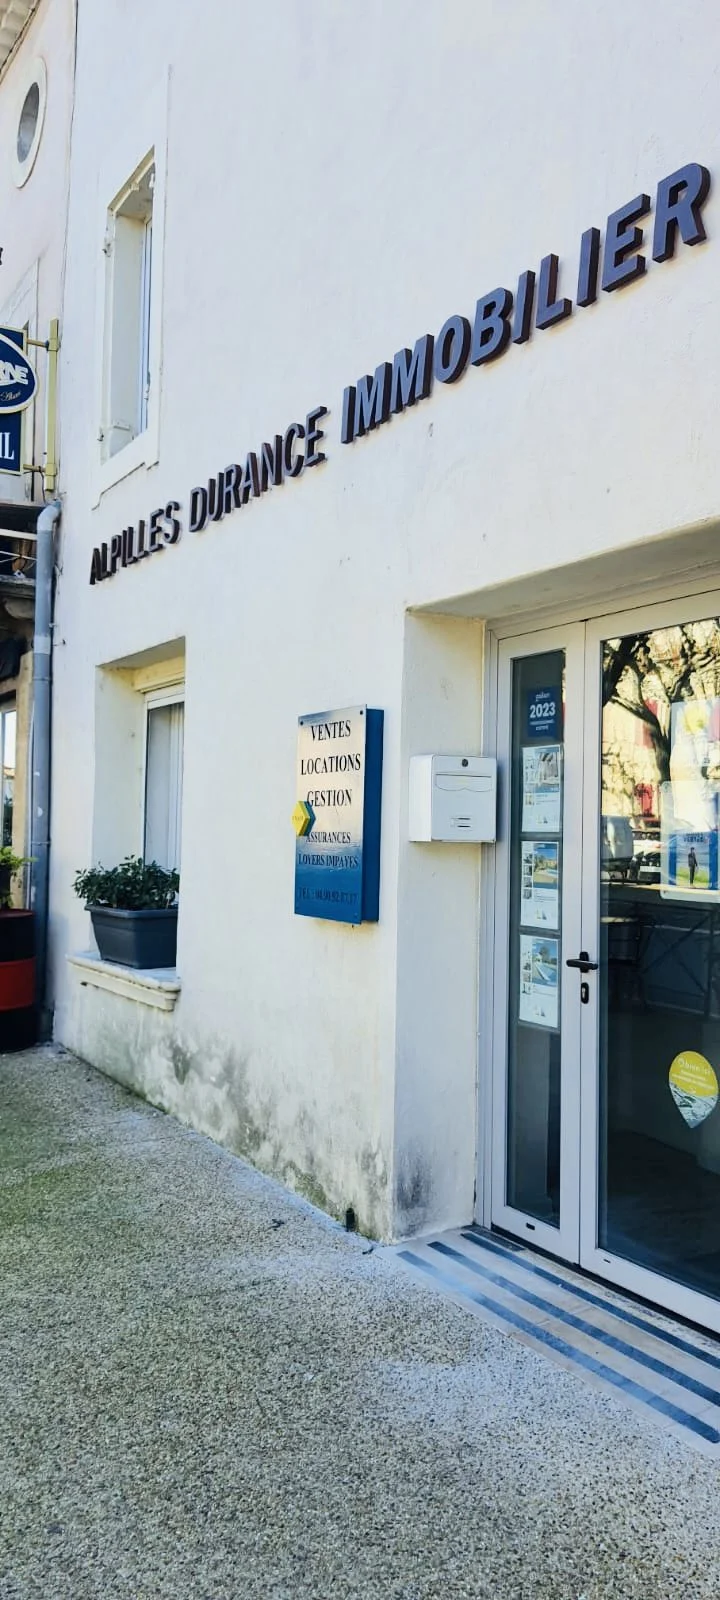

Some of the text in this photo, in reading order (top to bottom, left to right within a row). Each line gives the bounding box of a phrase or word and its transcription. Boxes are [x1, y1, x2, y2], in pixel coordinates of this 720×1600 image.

[90, 163, 711, 585] ALPILLES DURANCE IMMOBILIER
[530, 702, 556, 718] 2023
[311, 720, 351, 741] VENTES
[301, 754, 361, 775] LOCATIONS
[307, 789, 352, 806] GESTION
[306, 832, 351, 843] ASSURANCES
[299, 853, 325, 866] LOYERS
